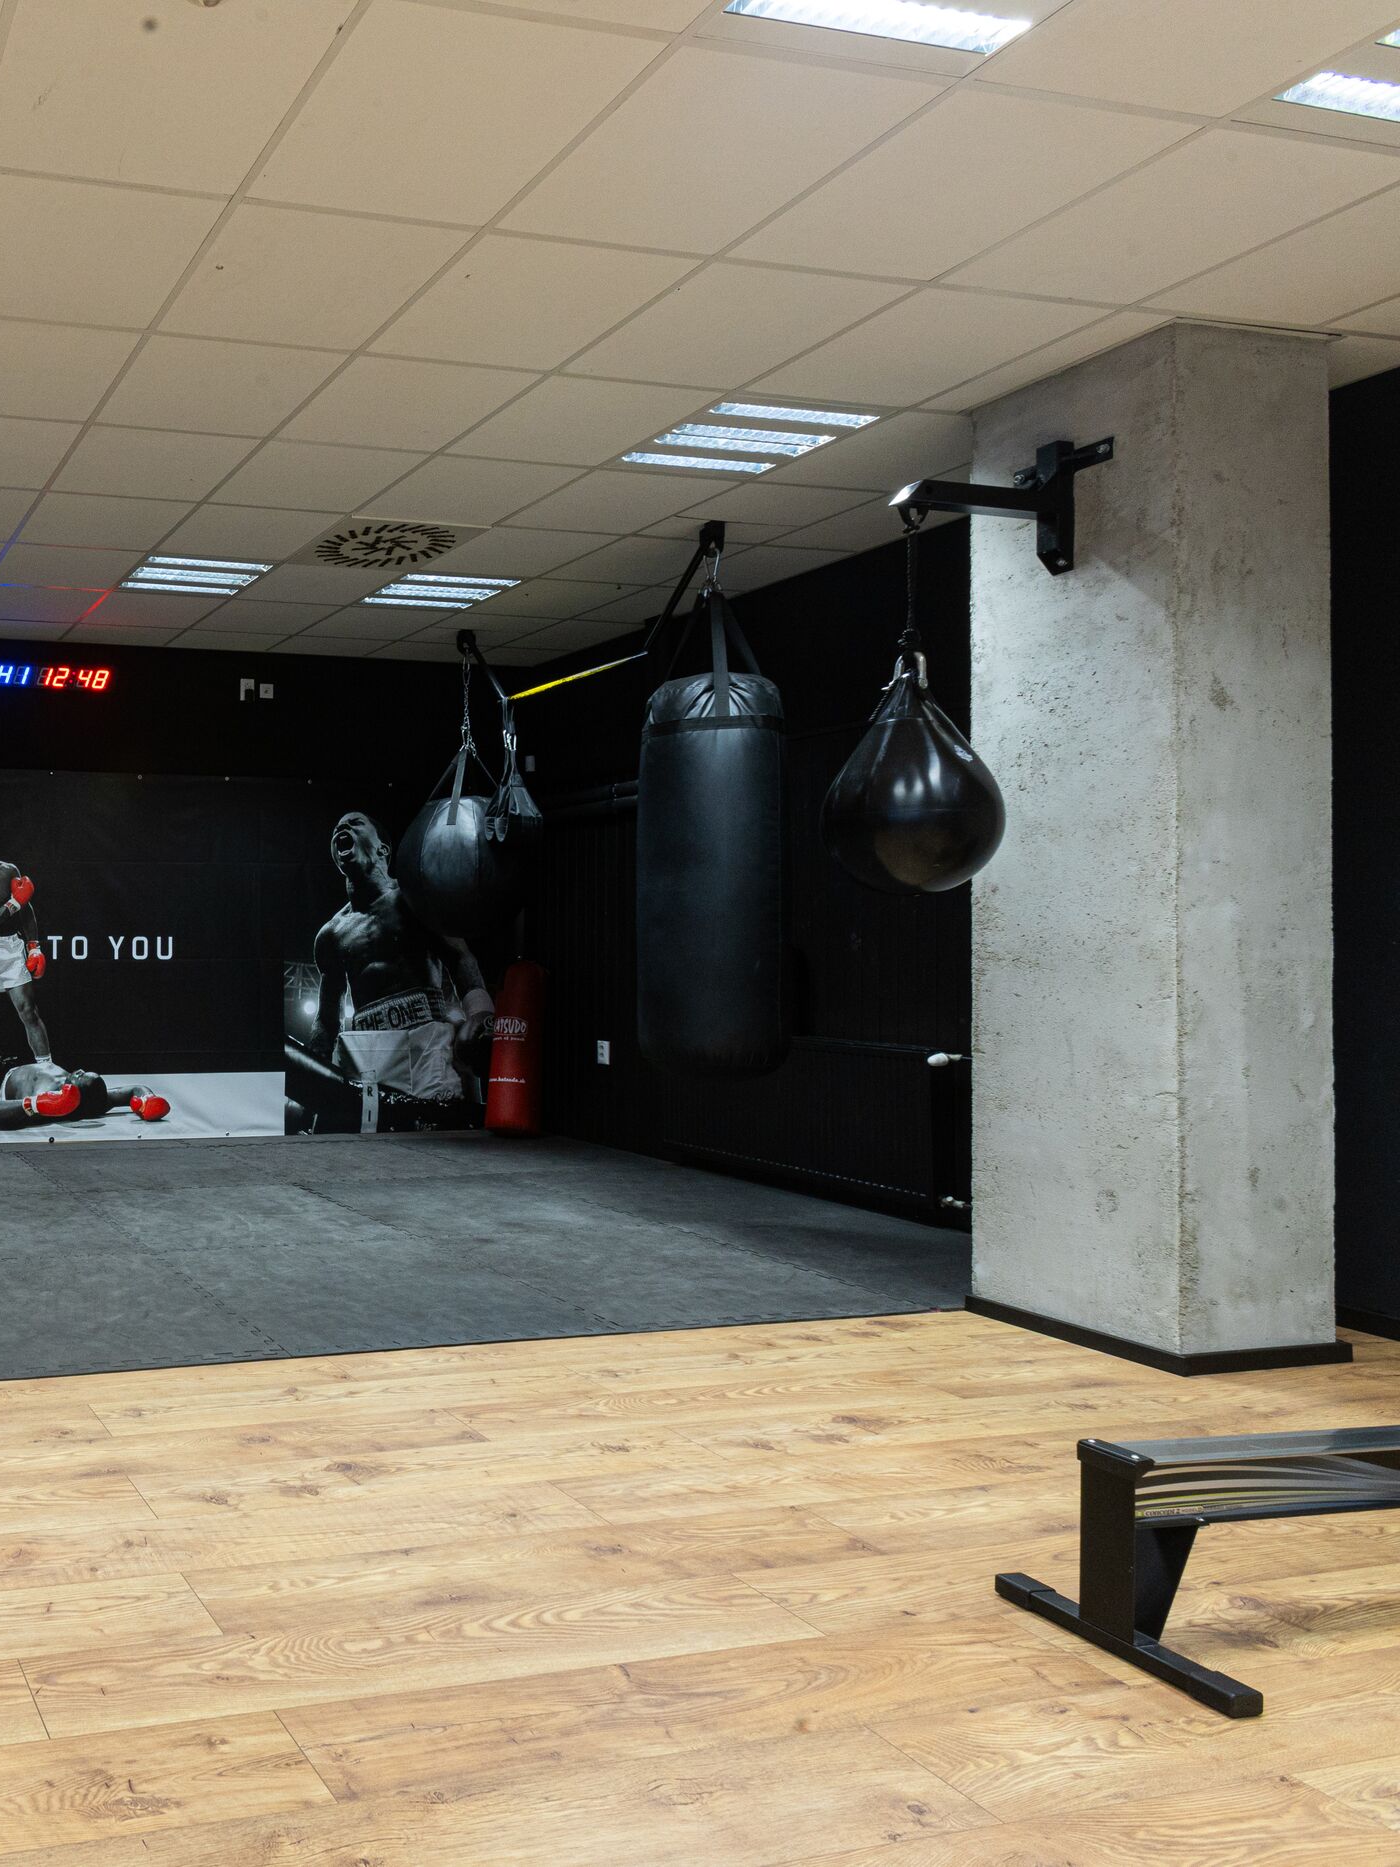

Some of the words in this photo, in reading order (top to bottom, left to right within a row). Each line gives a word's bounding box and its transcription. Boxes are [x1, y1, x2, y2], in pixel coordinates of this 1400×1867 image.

[48, 935, 88, 960] TO
[108, 935, 174, 961] YOU
[387, 997, 427, 1027] ONE
